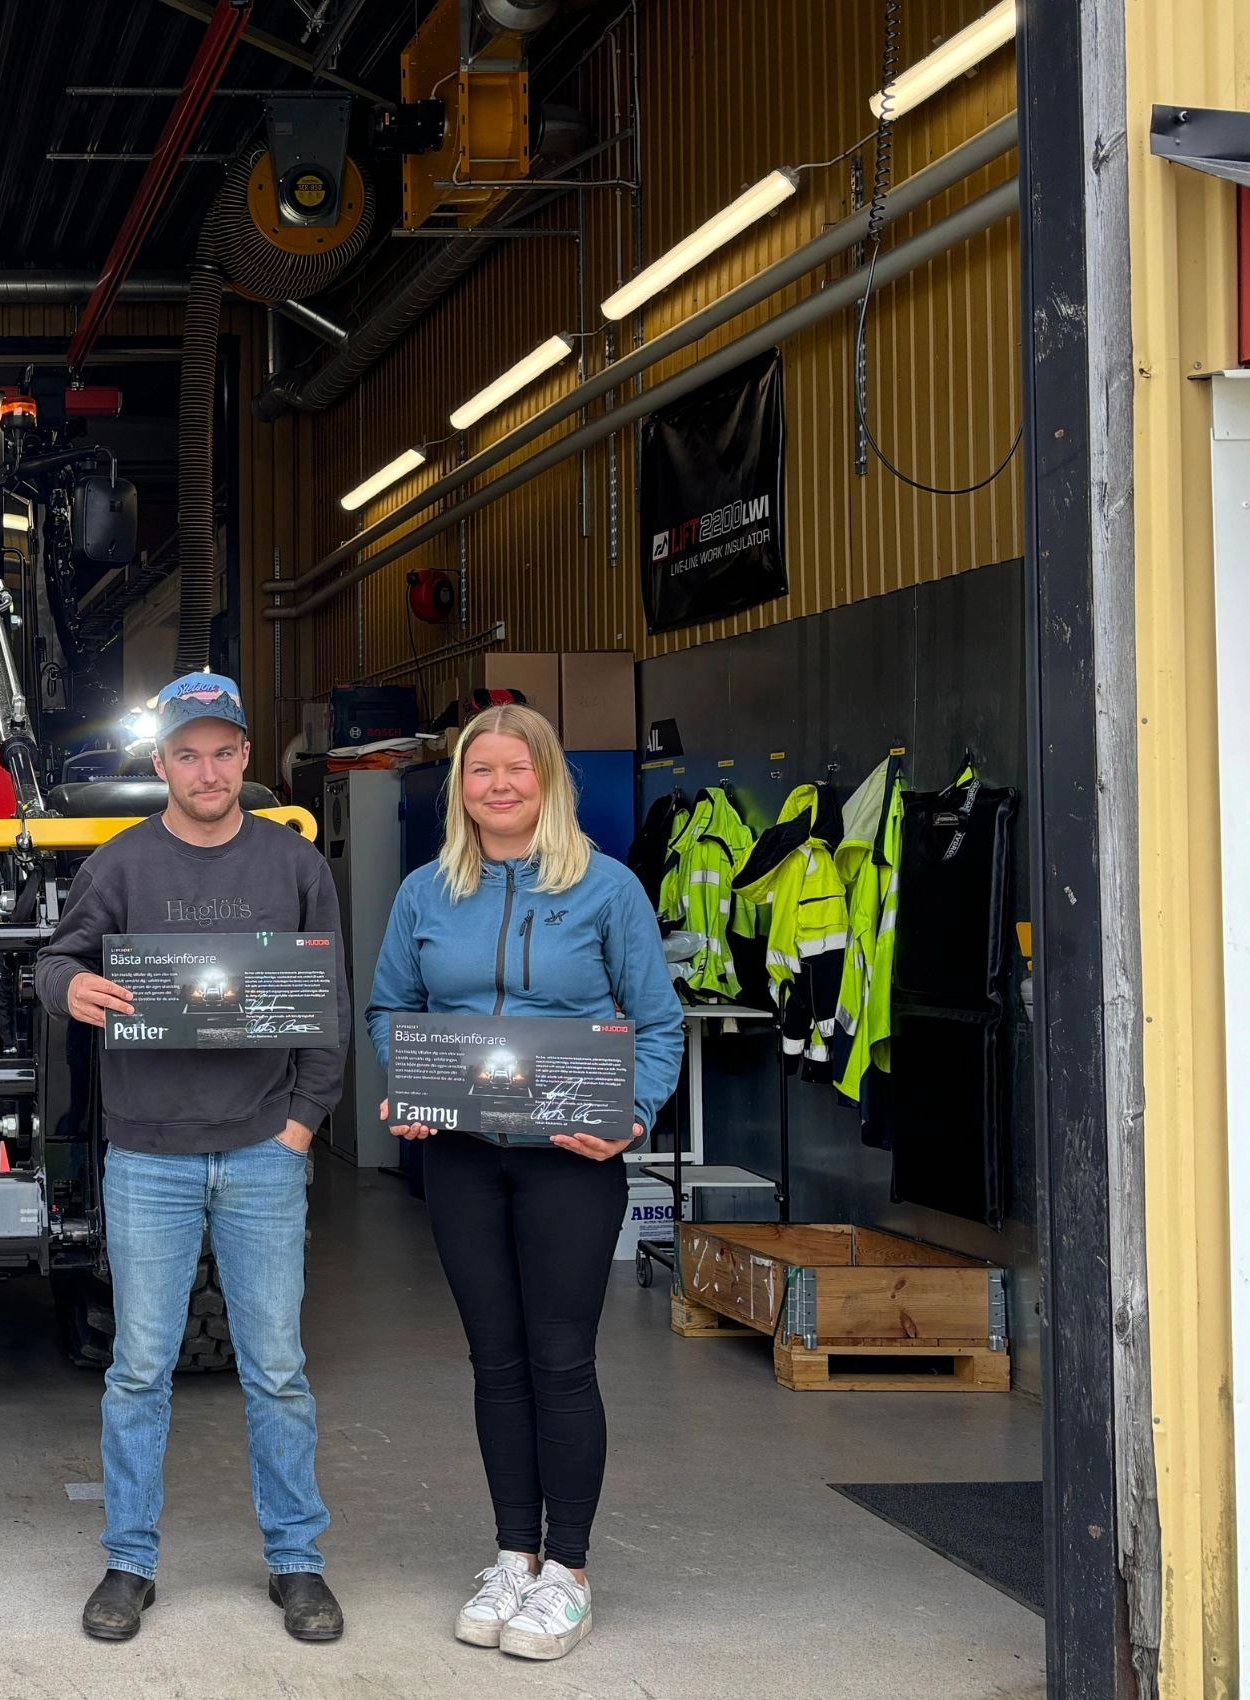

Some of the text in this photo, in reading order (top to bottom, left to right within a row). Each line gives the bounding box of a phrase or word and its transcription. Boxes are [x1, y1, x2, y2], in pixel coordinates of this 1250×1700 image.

[700, 545, 723, 564] WORK
[724, 528, 771, 557] INSULATOR
[164, 896, 253, 928] Haglöfs
[110, 953, 217, 965] Bästa maskinförare
[114, 1022, 169, 1041] Petter
[395, 1030, 507, 1046] Bästa maskinförare
[396, 1101, 458, 1130] Fanny
